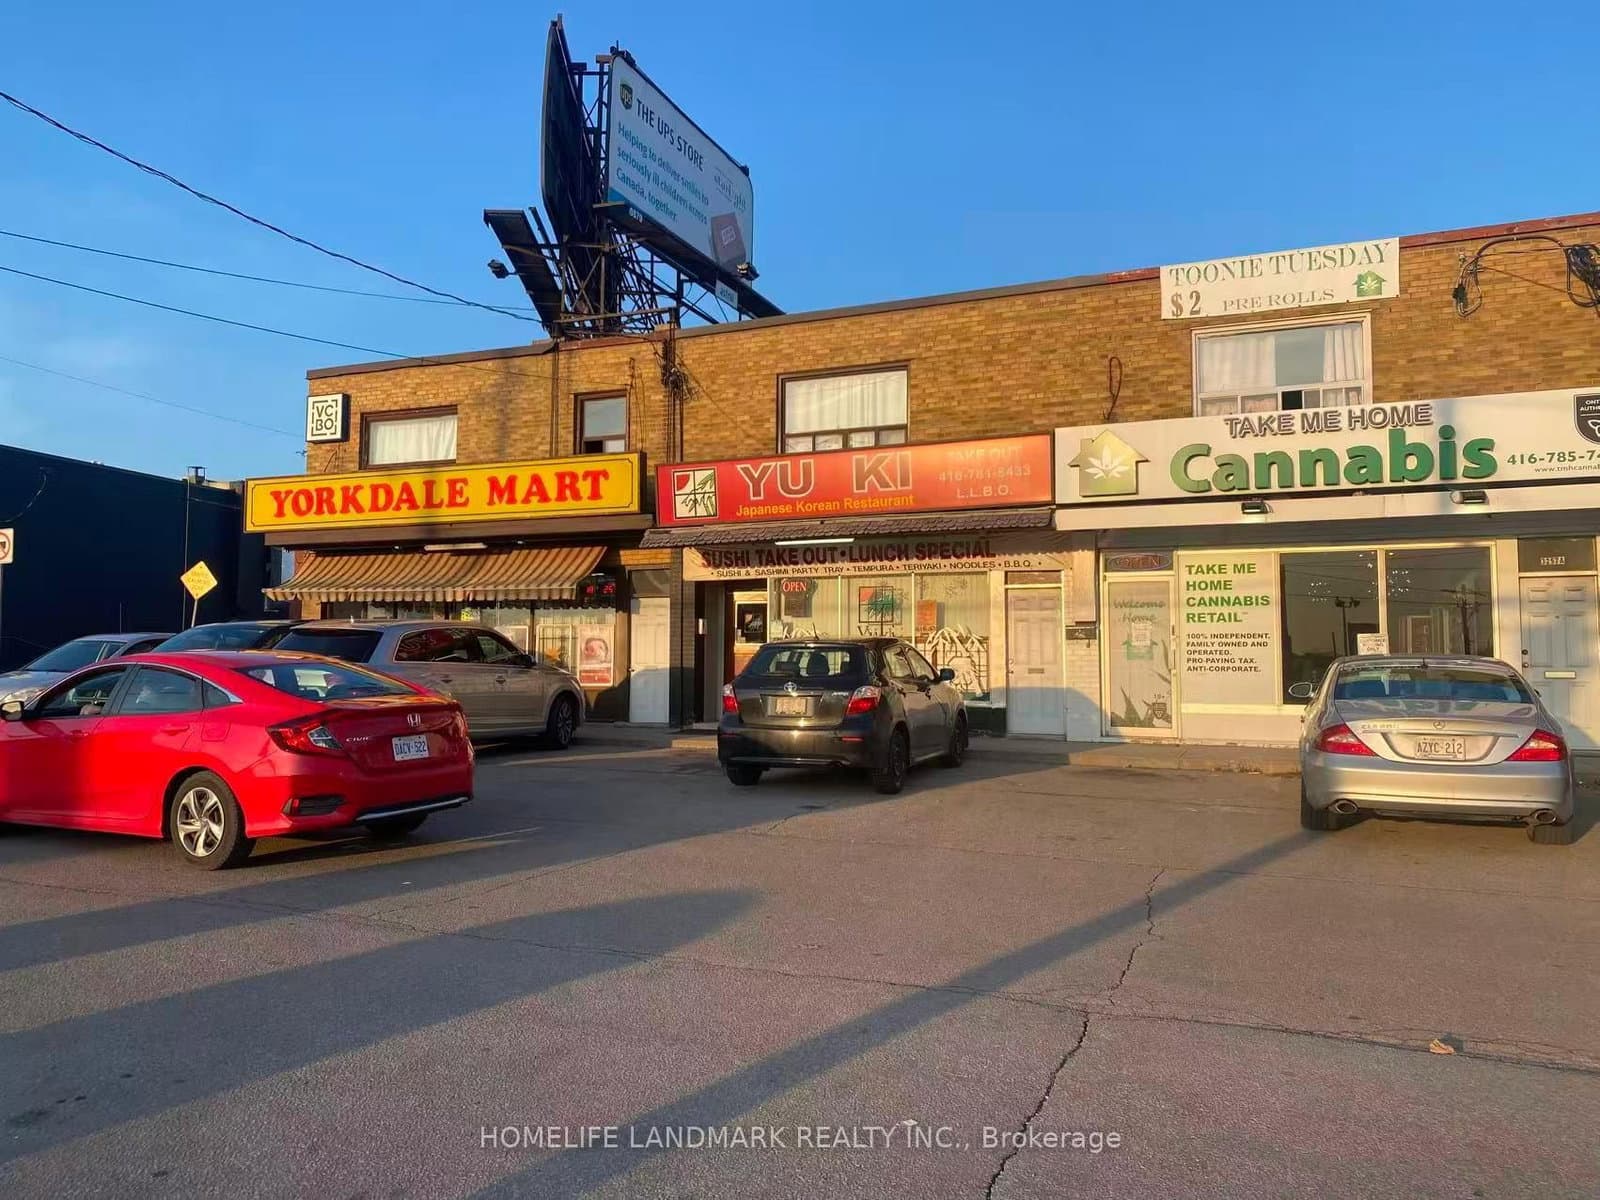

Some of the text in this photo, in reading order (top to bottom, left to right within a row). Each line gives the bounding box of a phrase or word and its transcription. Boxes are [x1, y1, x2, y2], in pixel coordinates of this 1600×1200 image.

[617, 121, 648, 158] Helping
[648, 147, 657, 162] to
[636, 98, 704, 172] THE UPS STORE
[617, 146, 652, 184] seriously
[616, 166, 678, 224] Canada, together.
[1169, 242, 1392, 287] TOONIE TUESDAY
[1223, 297, 1262, 312] PRE
[1268, 288, 1336, 307] ROLLS
[316, 404, 334, 418] VC
[1224, 403, 1434, 439] TAKE ME HOME
[315, 418, 334, 431] BO
[1169, 424, 1499, 494] Cannabis
[736, 450, 913, 501] YU KI
[269, 468, 611, 518] YORKDALE MART
[736, 494, 915, 518] Japanese Korean Restaurant
[701, 539, 996, 568] SUSHI TAKE OUT LUNCH SPECIAL
[755, 568, 789, 576] SASHIMI
[792, 566, 819, 575] PARTY
[824, 566, 844, 574] TRAY
[853, 564, 894, 573] TEMPURA
[902, 563, 942, 571] TERIYAKI
[949, 561, 996, 569] NOODLES
[1004, 560, 1034, 568] B.B.Q.
[1185, 563, 1257, 575] TAKE ME
[782, 580, 807, 592] OPEN
[1186, 580, 1233, 591] HOME
[1113, 600, 1166, 608] Welcome
[1186, 595, 1271, 607] CANNABIS
[1121, 612, 1157, 623] Home
[1186, 665, 1261, 673] ANTI-CORPORATE.
